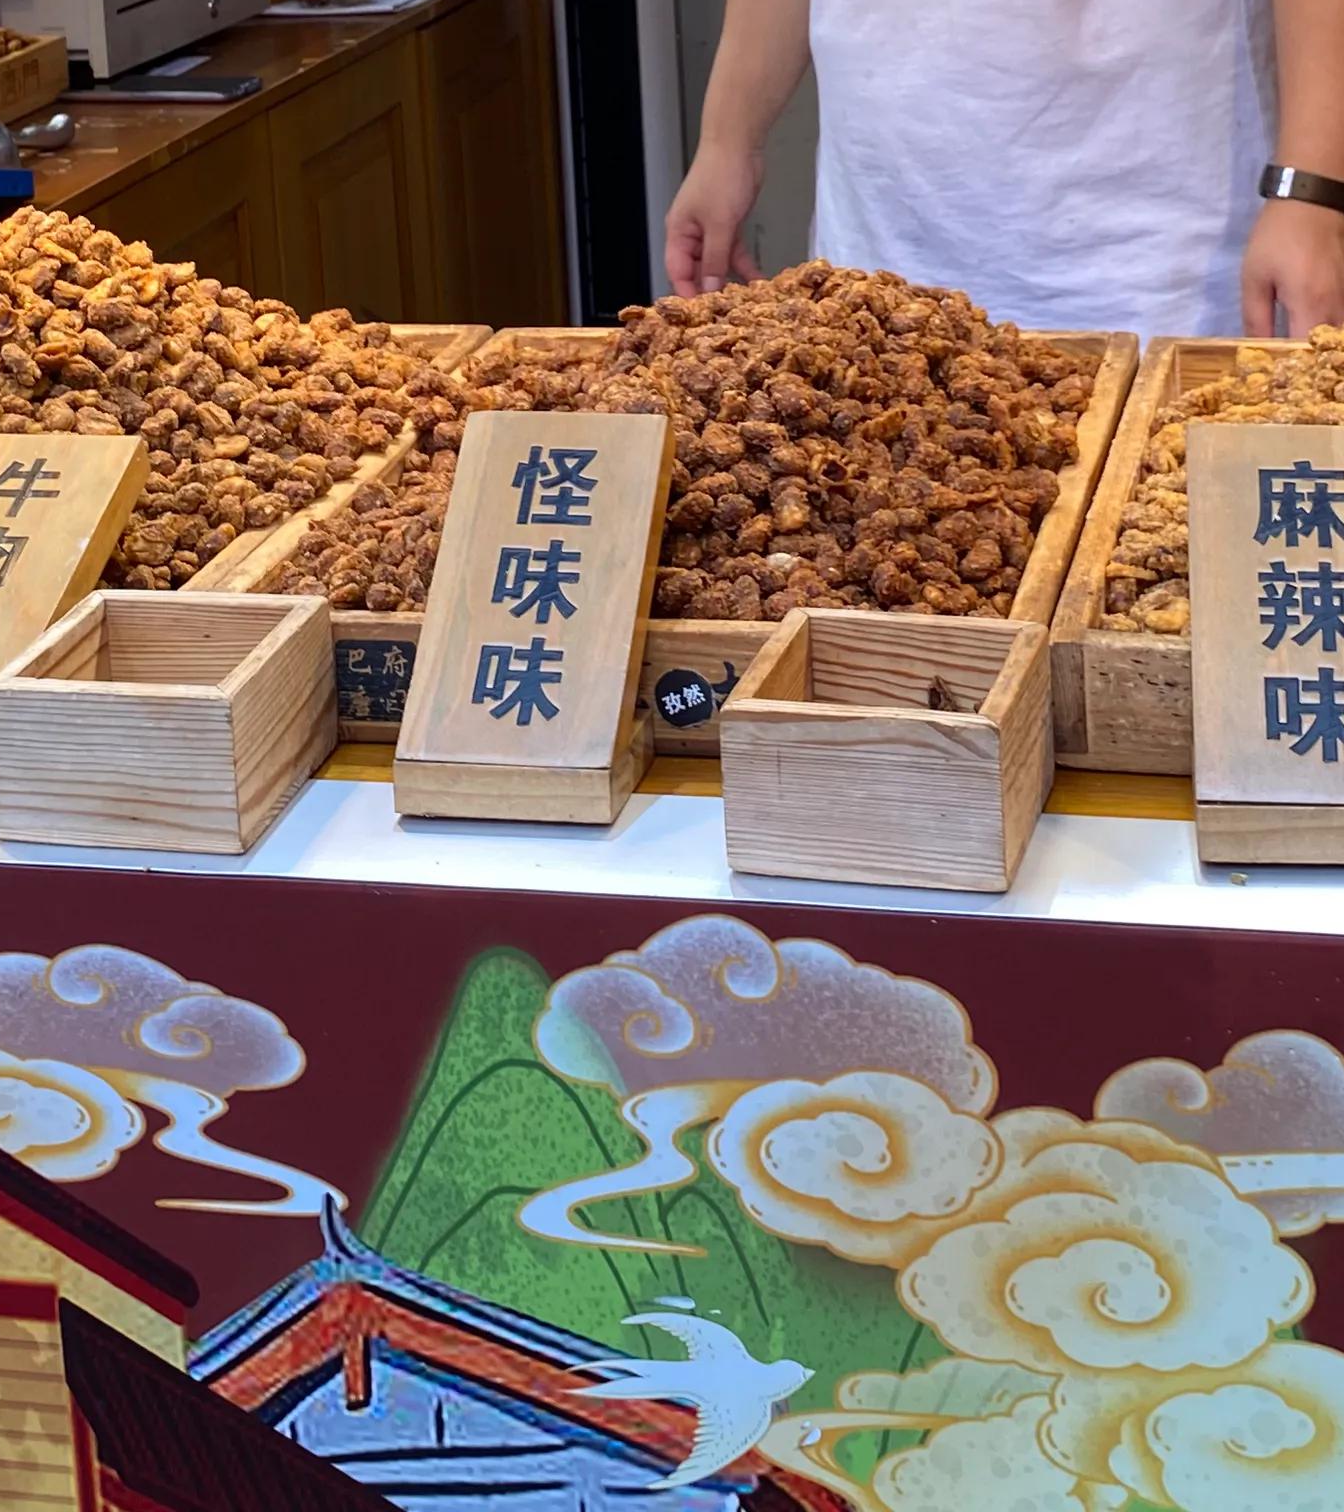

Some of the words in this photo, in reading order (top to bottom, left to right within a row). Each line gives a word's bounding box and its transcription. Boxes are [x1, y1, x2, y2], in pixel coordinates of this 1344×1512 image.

[471, 445, 600, 727] 怪味味
[661, 683, 707, 716] 孜然
